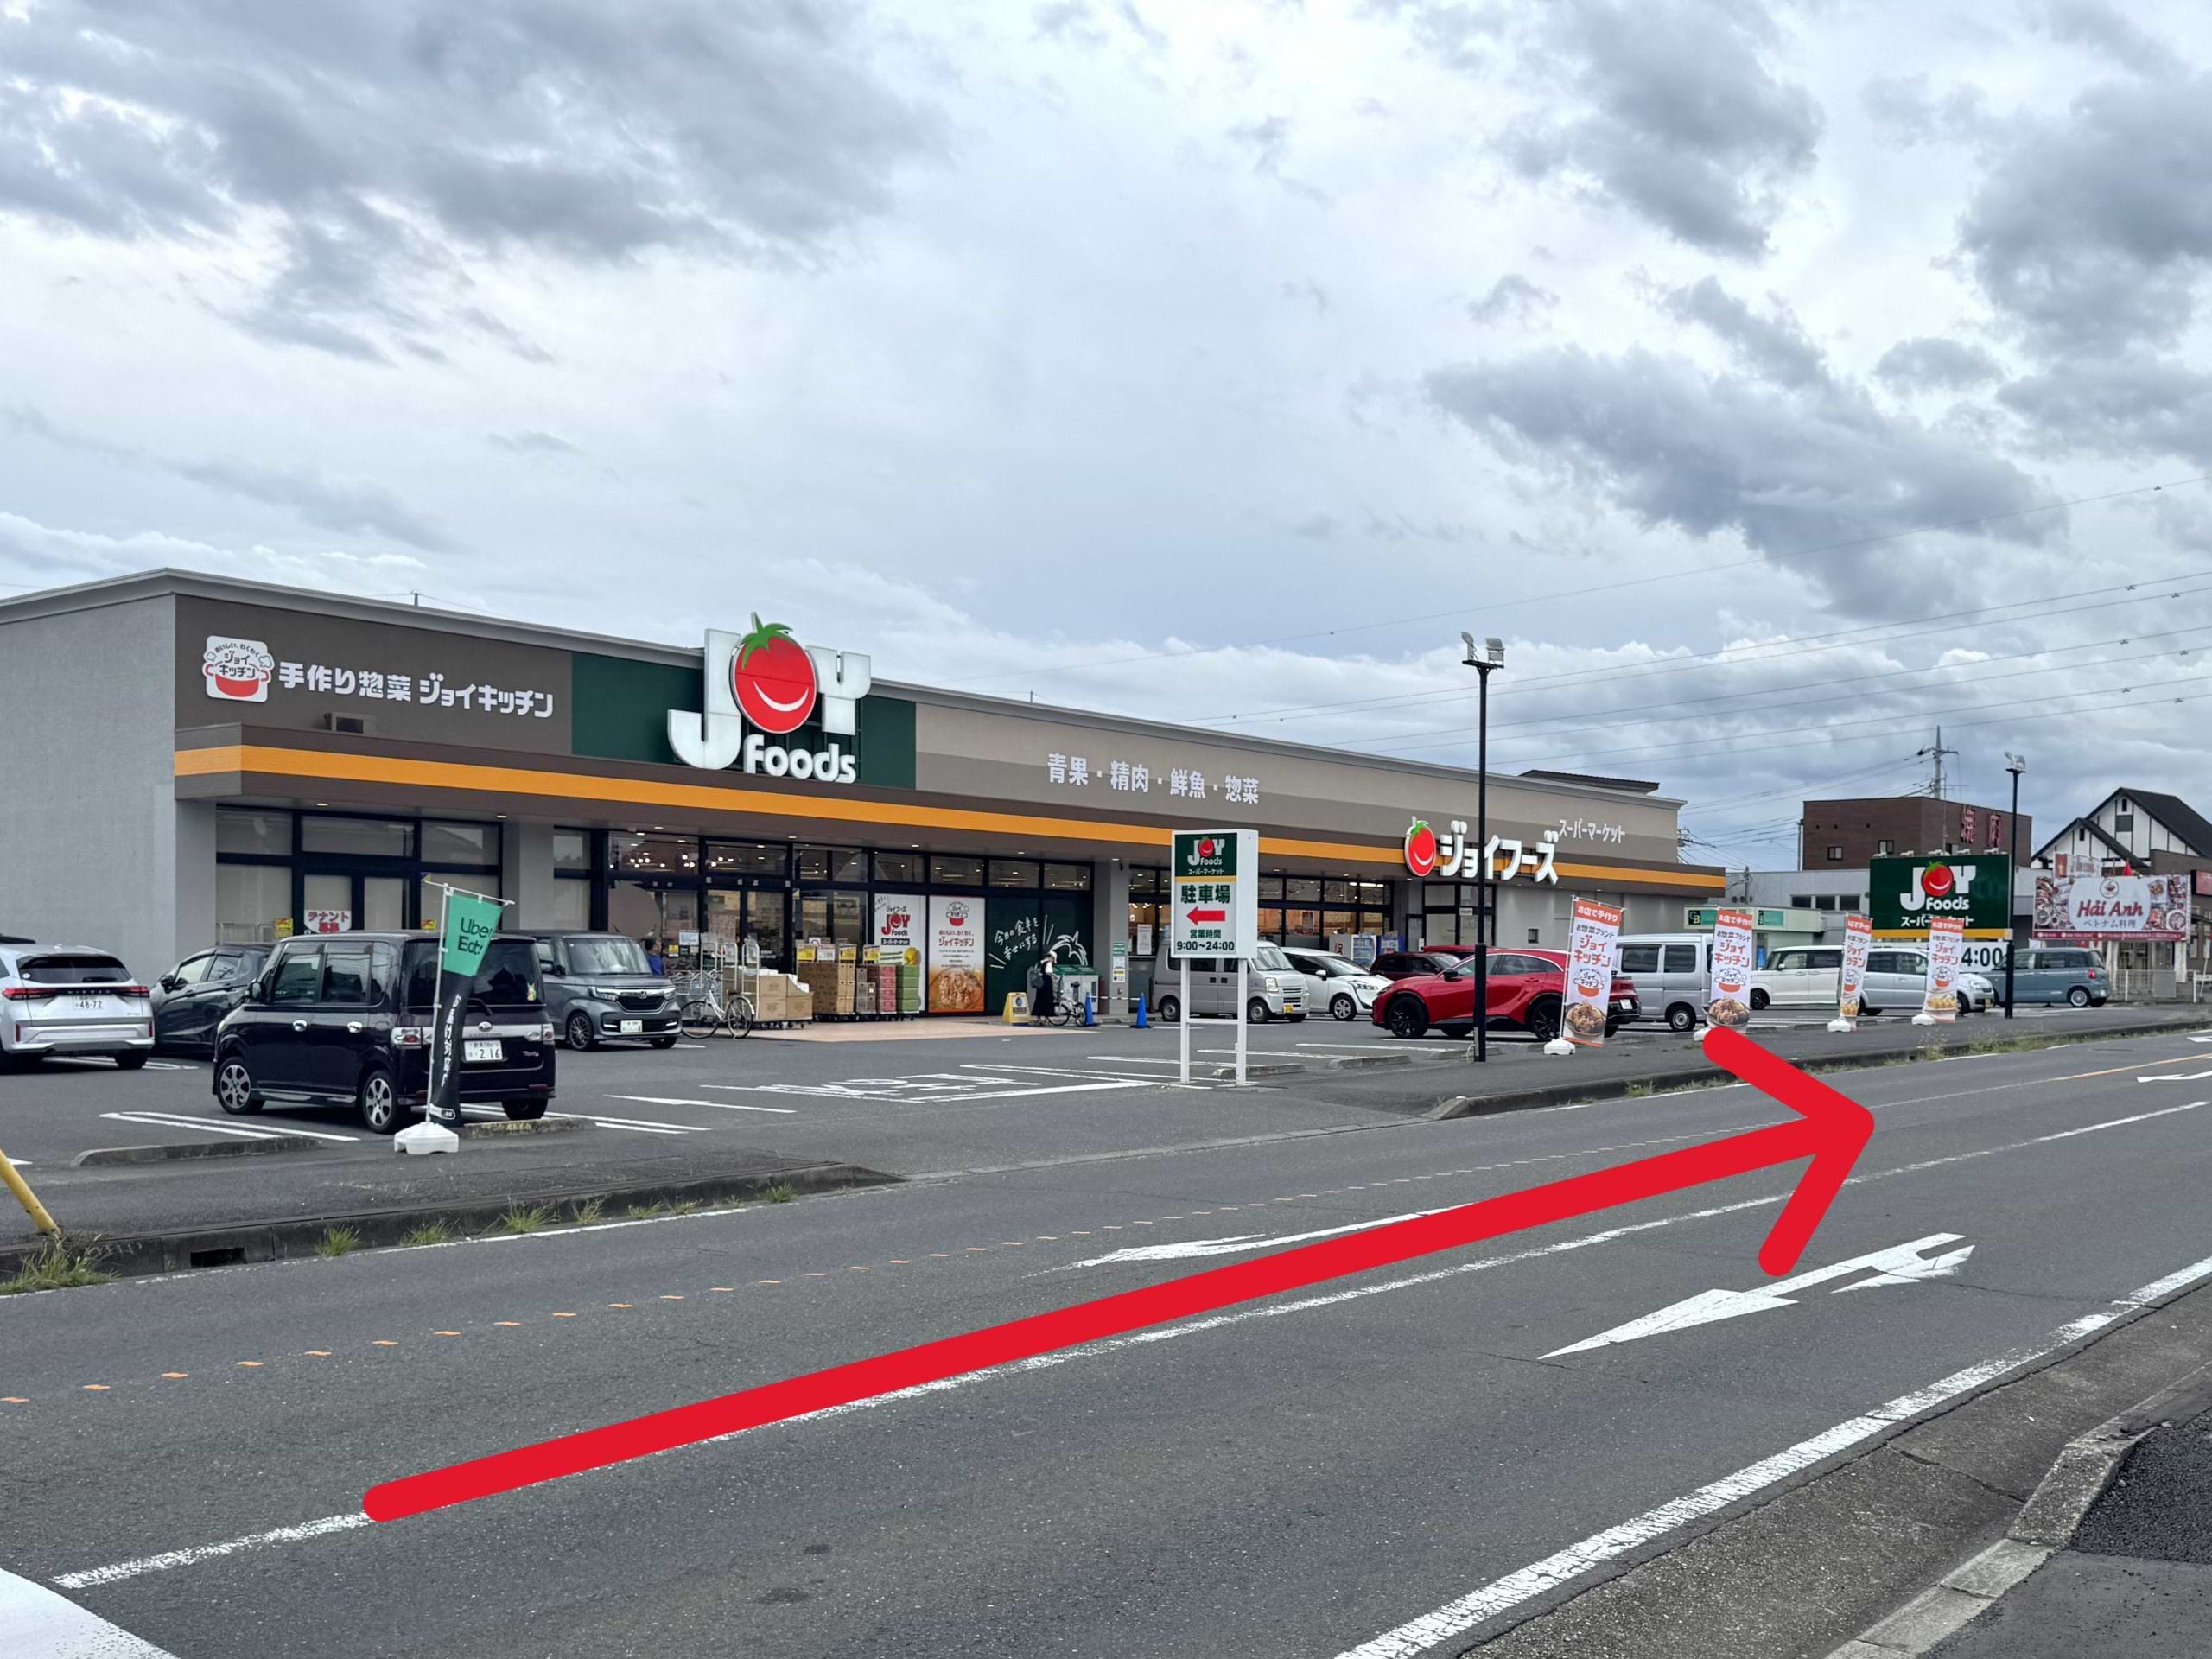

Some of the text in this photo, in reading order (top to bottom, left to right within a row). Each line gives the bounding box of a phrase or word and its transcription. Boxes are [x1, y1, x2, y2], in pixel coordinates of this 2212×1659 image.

[224, 651, 251, 664] ジョイ
[219, 664, 256, 678] キッチン
[278, 661, 554, 718] 手作り惣菜 ジョイキッチン
[667, 612, 871, 770] JOY
[1558, 817, 1625, 844] スーパーマーケット
[1440, 820, 1559, 885] ジョイフーズ
[1180, 884, 1230, 904] 駐車場
[308, 911, 349, 923] テナント
[2108, 901, 2144, 917] Anh
[2083, 918, 2137, 929] ベトナム料理
[1190, 929, 1221, 939] 営業時間
[1580, 934, 1607, 952] ジョイ
[1719, 938, 1745, 954] ジョイ
[1573, 949, 1611, 968] キッチン
[1713, 952, 1751, 968] キッチン
